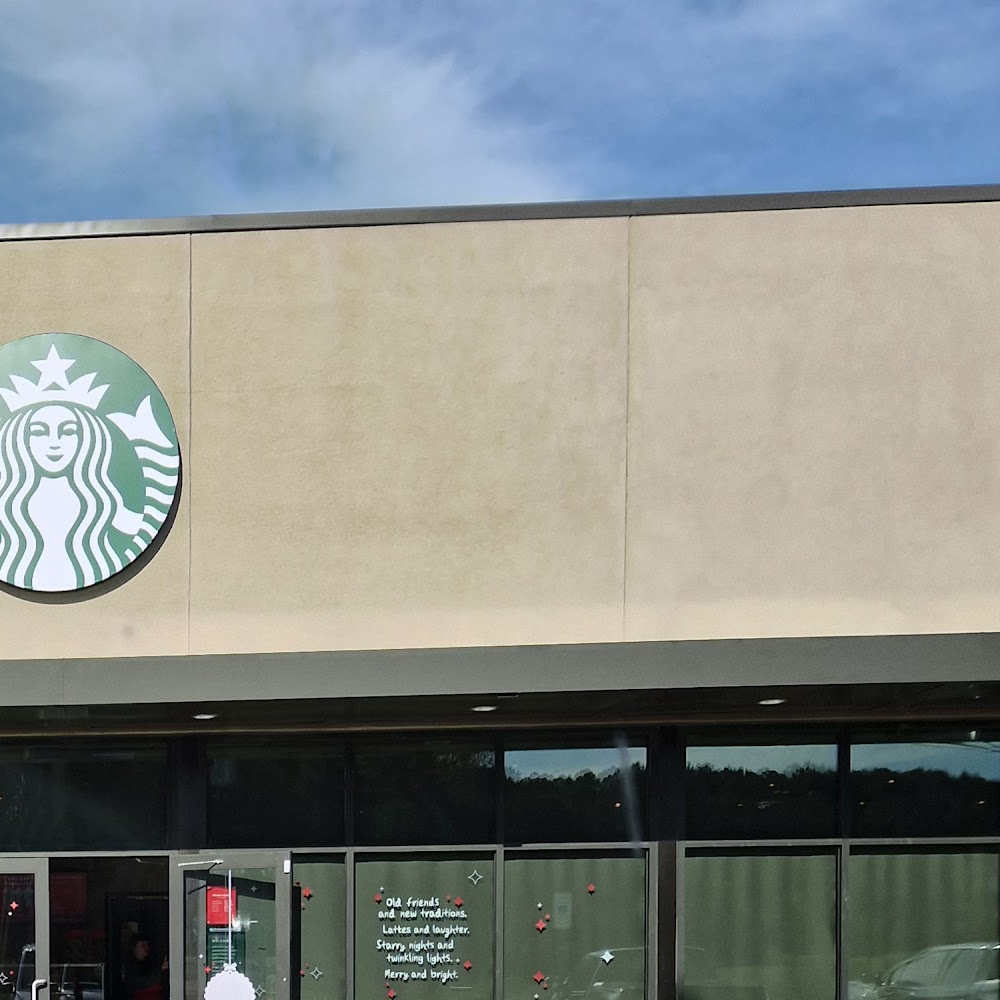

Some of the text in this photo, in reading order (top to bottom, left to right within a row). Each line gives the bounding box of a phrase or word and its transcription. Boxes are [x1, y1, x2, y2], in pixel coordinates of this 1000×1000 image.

[386, 897, 439, 907] Old friends
[378, 910, 396, 918] and
[420, 909, 468, 918] traditions.
[382, 924, 470, 938] Lattes and laughter.
[376, 939, 454, 952] Starry nights and
[386, 953, 453, 964] twinkling lights.
[384, 969, 458, 982] Merry and bright.
